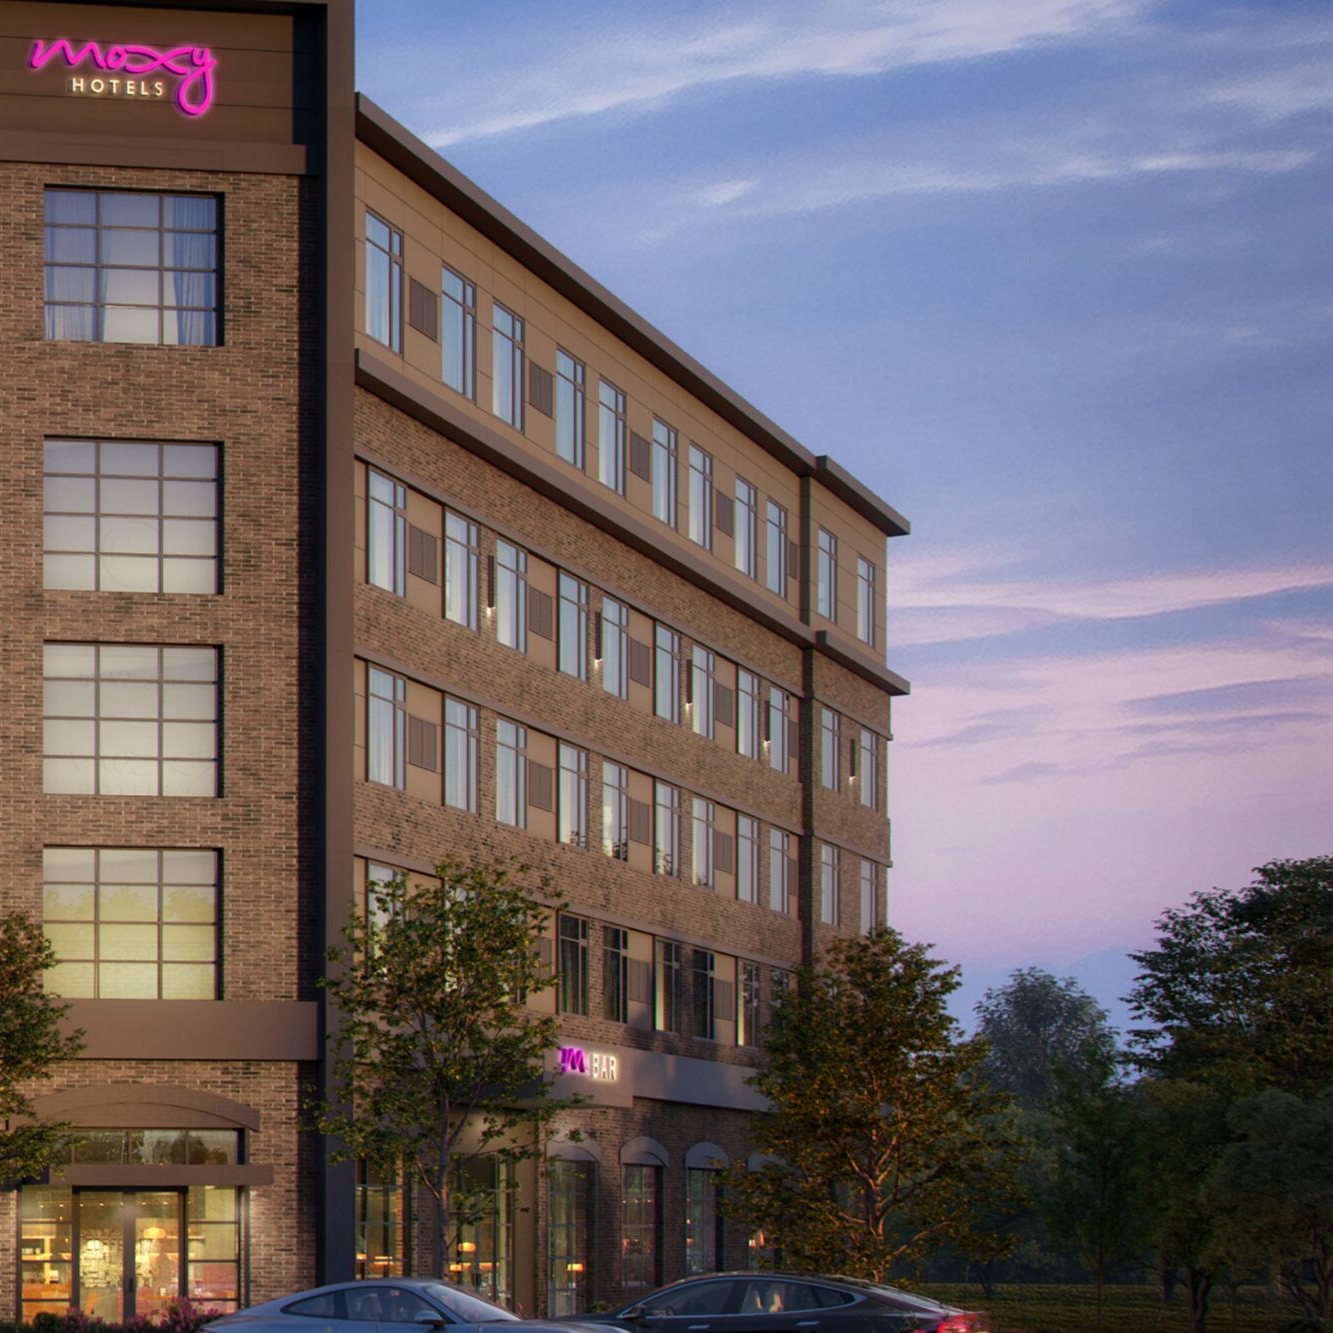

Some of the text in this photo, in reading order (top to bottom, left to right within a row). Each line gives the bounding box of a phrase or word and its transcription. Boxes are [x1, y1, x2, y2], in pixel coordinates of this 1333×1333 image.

[30, 39, 217, 115] moxy
[71, 77, 164, 97] HOTELS
[592, 1053, 618, 1081] BAR
